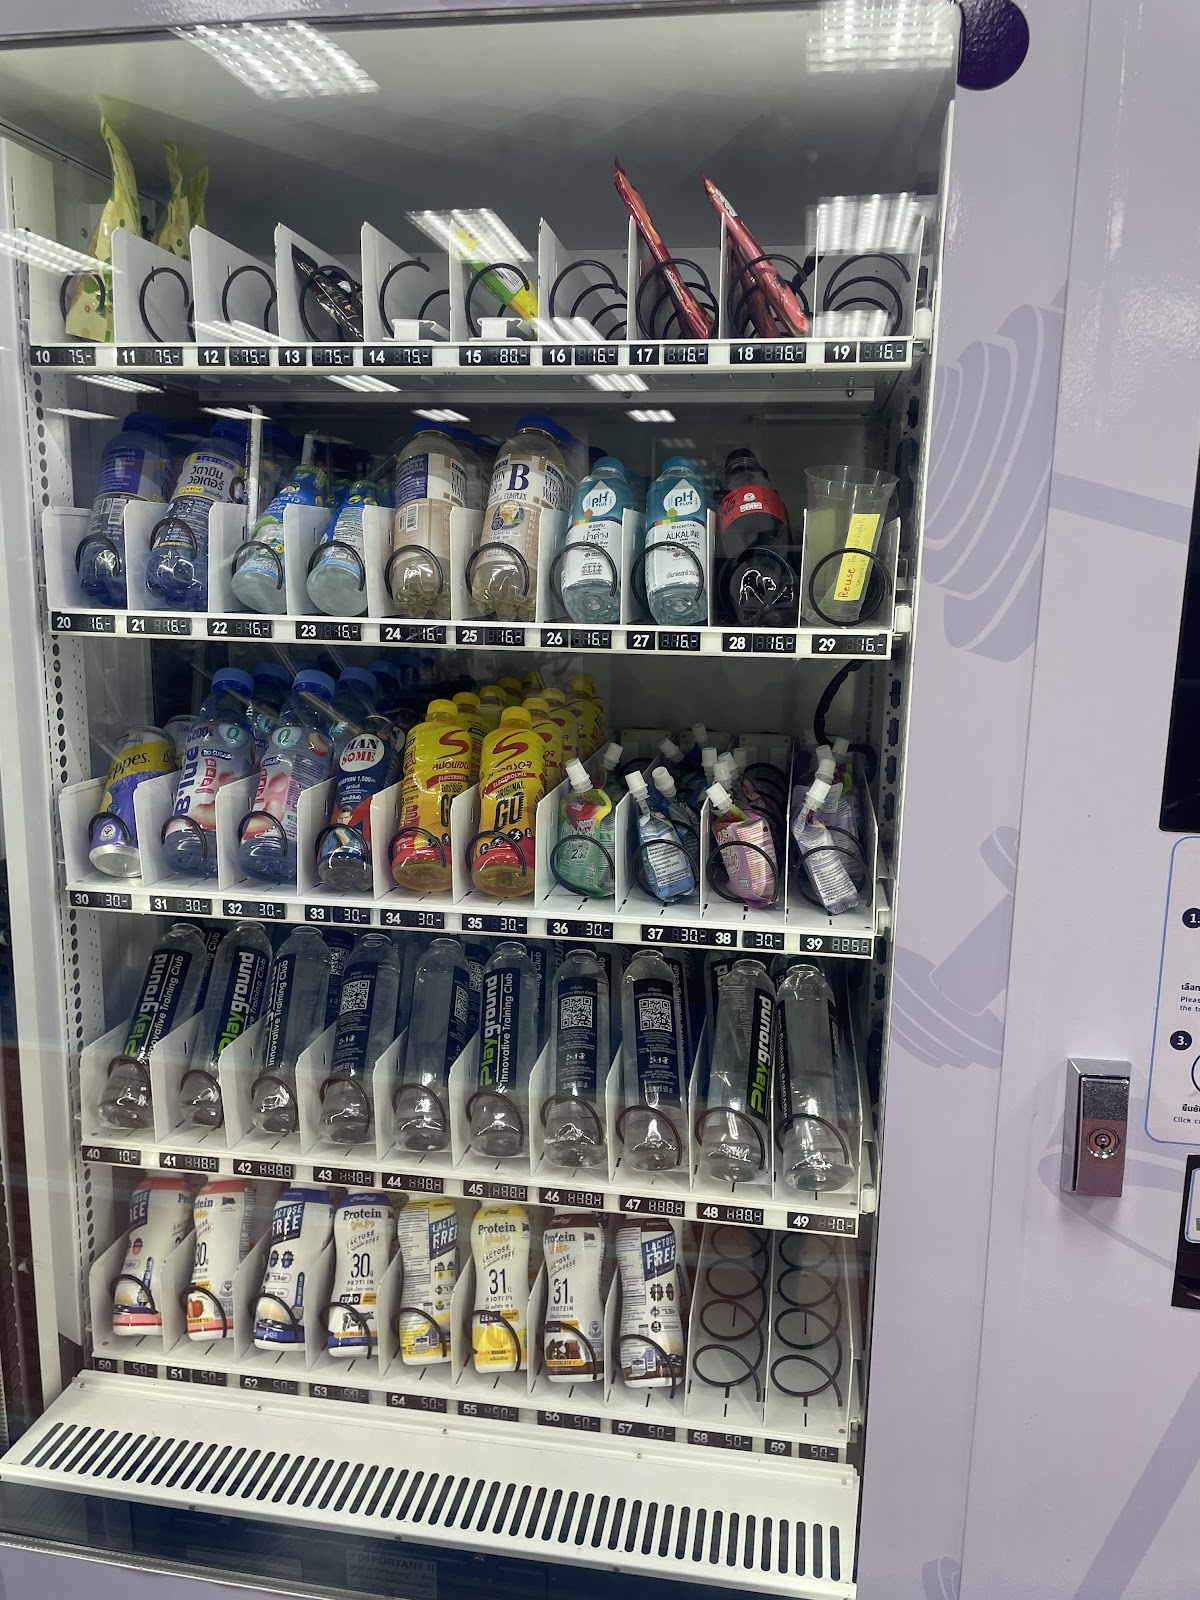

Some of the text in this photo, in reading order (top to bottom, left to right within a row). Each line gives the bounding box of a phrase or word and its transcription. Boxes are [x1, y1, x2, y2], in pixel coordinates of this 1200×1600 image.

[36, 350, 51, 363] 10
[123, 350, 136, 363] 11
[204, 350, 220, 363] 12
[284, 350, 300, 363] 13
[369, 350, 385, 363] 14
[465, 350, 481, 363] 15
[549, 349, 566, 362] 16
[637, 348, 653, 362] 17
[737, 346, 753, 360] 18
[833, 345, 850, 359] 19
[506, 463, 530, 491] B
[504, 492, 528, 501] COMPLEX
[674, 491, 695, 507] pH
[679, 500, 694, 508] PLUS
[665, 530, 701, 541] ALKALINE
[838, 567, 856, 599] Reuse
[56, 616, 71, 629] 20
[131, 618, 145, 632] 21
[212, 621, 228, 635] 22
[300, 623, 316, 637] 23
[385, 626, 401, 640] 24
[461, 629, 477, 642] 25
[546, 631, 563, 644] 26
[632, 634, 649, 647] 27
[729, 636, 746, 650] 28
[818, 638, 836, 651] 29
[341, 751, 376, 766] SOME
[494, 791, 525, 832] GO
[75, 893, 90, 905] 30
[154, 898, 168, 910] 31
[228, 902, 243, 915] 32
[309, 907, 325, 920] 33
[385, 912, 401, 924] 34
[467, 917, 483, 930] 35
[552, 922, 569, 935] 36
[647, 927, 663, 940] 37
[715, 931, 731, 945] 38
[806, 937, 823, 950] 39
[257, 957, 267, 978] Club
[280, 959, 290, 979] Club
[160, 971, 179, 1012] Training
[173, 955, 185, 980] Club
[217, 950, 256, 1055] Playground
[275, 978, 288, 1017] Training
[123, 952, 169, 1058] Playground
[480, 974, 499, 1088] Playground
[501, 972, 514, 1083] Innovative Training Club
[268, 1016, 282, 1067] Innovative
[1177, 1035, 1188, 1046] 3.
[750, 994, 773, 1115] Playground
[86, 1148, 100, 1159] 40
[163, 1154, 176, 1166] 41
[238, 1162, 252, 1173] 42
[317, 1169, 332, 1181] 43
[386, 1176, 401, 1188] 44
[468, 1184, 483, 1195] 45
[544, 1191, 559, 1203] 46
[625, 1199, 641, 1211] 47
[342, 1208, 382, 1219] Protein
[702, 1206, 719, 1218] 48
[272, 1214, 300, 1235] FREE
[793, 1215, 809, 1227] 49
[477, 1222, 517, 1235] Protein
[346, 1230, 376, 1248] LACTOSE
[544, 1230, 576, 1245] Protein
[645, 1234, 676, 1253] LACTOSE
[482, 1244, 510, 1264] LACTOSE
[646, 1248, 675, 1271] FREE
[345, 1278, 374, 1286] PROTEIN
[340, 1295, 360, 1304] ZERO
[485, 1295, 513, 1303] PROTEIN
[99, 1359, 112, 1370] 50
[170, 1368, 183, 1379] 51
[244, 1377, 259, 1389] 52
[313, 1385, 327, 1396] 53
[391, 1394, 406, 1406] 54
[462, 1404, 477, 1415] 55
[544, 1412, 560, 1422] 56
[617, 1422, 633, 1434] 57
[693, 1432, 708, 1444] 58
[770, 1441, 785, 1453] 59
[358, 1553, 424, 1571] IMPORTANT
